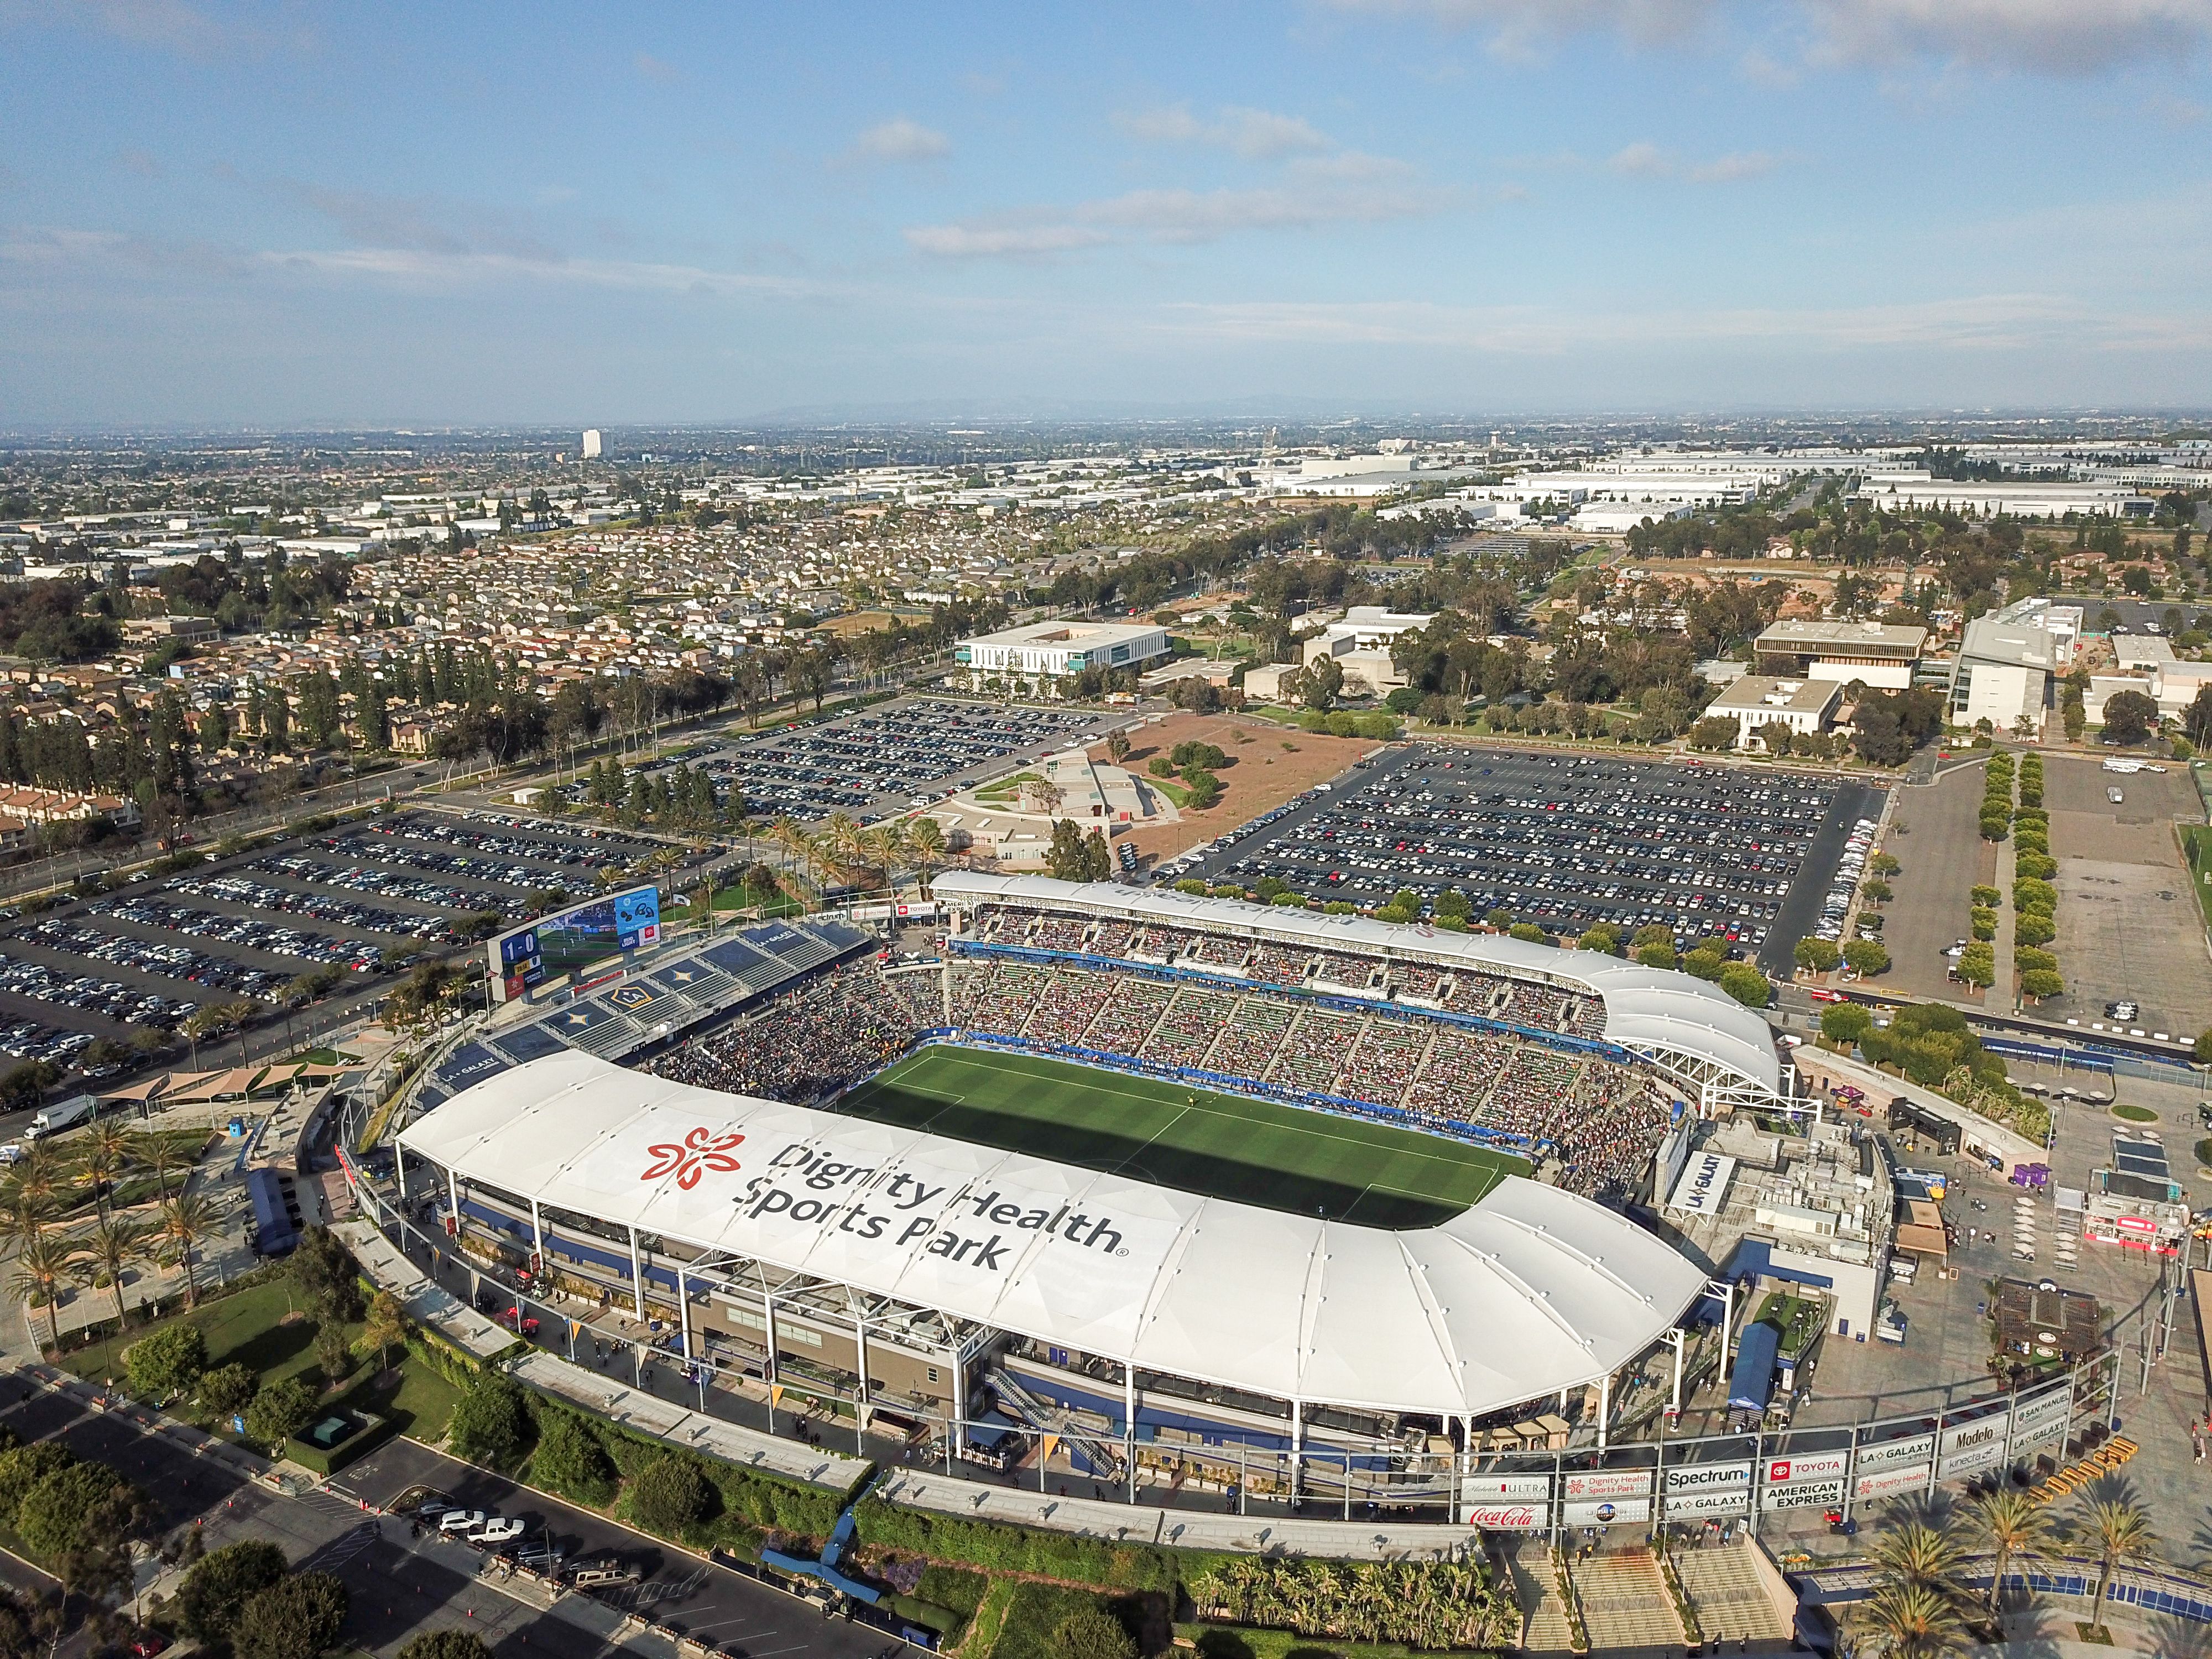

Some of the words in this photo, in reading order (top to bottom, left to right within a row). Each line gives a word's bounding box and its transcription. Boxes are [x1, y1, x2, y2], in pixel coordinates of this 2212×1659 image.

[808, 912, 844, 923] Sectrum
[508, 942, 514, 960] 1
[525, 933, 534, 952] 0
[622, 994, 645, 1003] LA
[461, 1057, 494, 1073] GALAXY
[1282, 1088, 1308, 1096] GALAXY
[1421, 1114, 1448, 1124] GALAXY
[1686, 1196, 1704, 1208] LA
[1695, 1154, 1720, 1188] GALAXY
[768, 1144, 946, 1209] Dignity
[945, 1183, 1124, 1255] Health
[732, 1176, 890, 1239] Sports
[896, 1222, 1013, 1271] Park
[2025, 1406, 2039, 1417] SAN
[2041, 1394, 2069, 1411] MANUEL
[1957, 1427, 1993, 1449] Modelo
[2014, 1439, 2024, 1449] LA
[2033, 1420, 2065, 1441] GALAXY
[1861, 1454, 1874, 1464] LA
[1887, 1442, 1931, 1458] GALAXY
[1949, 1453, 1980, 1468] kinecta
[1795, 1462, 1839, 1473] TOYOTA
[1589, 1477, 1619, 1486] Dignity
[1669, 1470, 1743, 1488] Spectrum
[1876, 1478, 1901, 1489] Dignity
[1903, 1473, 1926, 1483] Health
[1509, 1484, 1547, 1493] ULTRA
[1589, 1486, 1615, 1495] Sports
[1768, 1483, 1838, 1498] AMERICAN
[1666, 1502, 1682, 1511] LA
[1695, 1495, 1746, 1507] GALAXY
[1777, 1493, 1838, 1507] EXPRESS
[1470, 1507, 1535, 1525] Coca-Cola
